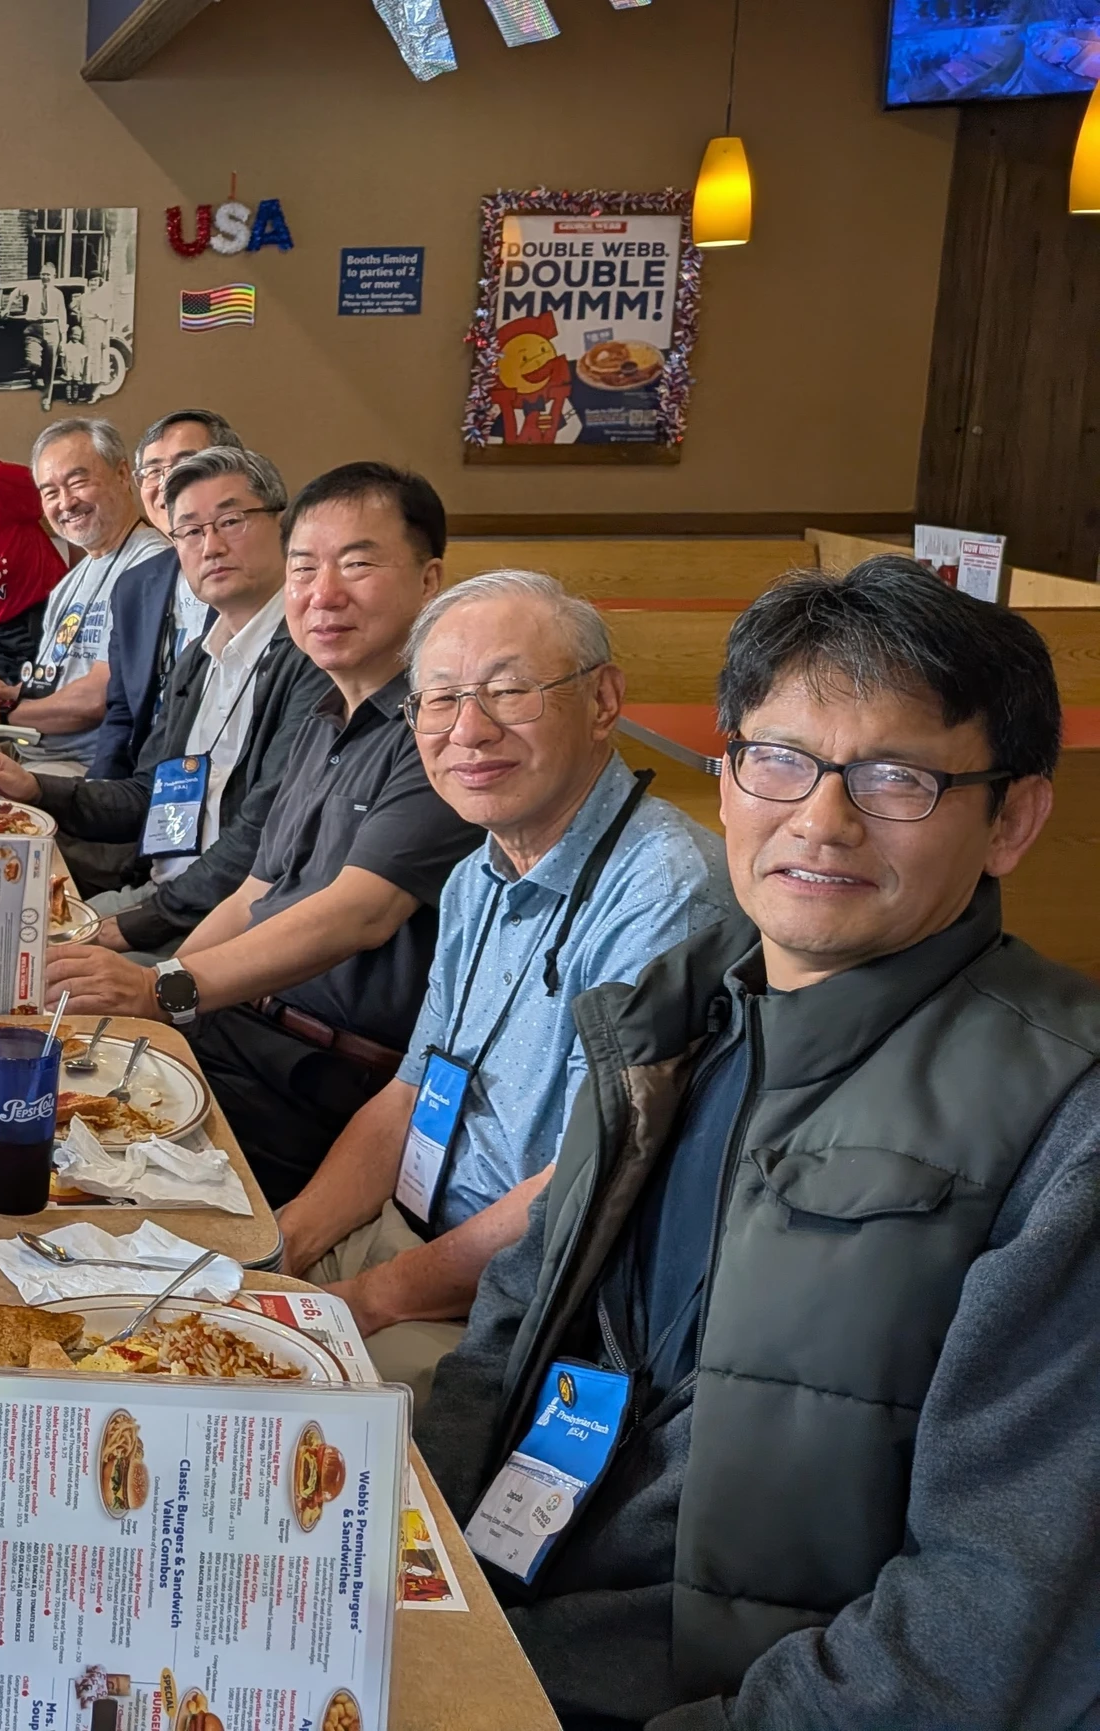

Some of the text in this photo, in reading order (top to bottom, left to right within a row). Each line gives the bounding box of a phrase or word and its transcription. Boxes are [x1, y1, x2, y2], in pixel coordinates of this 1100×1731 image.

[166, 199, 294, 258] USA
[347, 254, 418, 265] Booths limited
[506, 242, 670, 257] DOUBLE WEBB.
[347, 266, 415, 279] to parties of 2
[504, 260, 666, 288] DOUBLE
[502, 290, 664, 322] MMMM!
[8, 1404, 18, 1434] California
[82, 1408, 90, 1426] Super
[218, 1415, 227, 1426] The
[7, 1436, 16, 1456] Burger
[81, 1427, 89, 1450] George
[217, 1441, 225, 1462] Burger
[270, 1417, 281, 1486] Wisconsin Egg Burger
[30, 1448, 40, 1490] Cheeseburger
[242, 1416, 254, 1499] The Ultimate Super George
[356, 1471, 369, 1515] Webb's
[507, 1490, 524, 1502] Jacob
[534, 1506, 551, 1524] SYNOD
[159, 1499, 174, 1588] Value Combos
[170, 1459, 190, 1627] Classic Burgers & Sandwich
[338, 1508, 353, 1594] & Sandwiches
[353, 1519, 367, 1577] Premium
[296, 1556, 308, 1622] All-Star Cheeseburger
[161, 1674, 176, 1711] SPECIAL
[27, 1700, 43, 1731] Soup
[45, 1702, 56, 1726] Mrs.
[150, 1691, 162, 1731] BURGE
